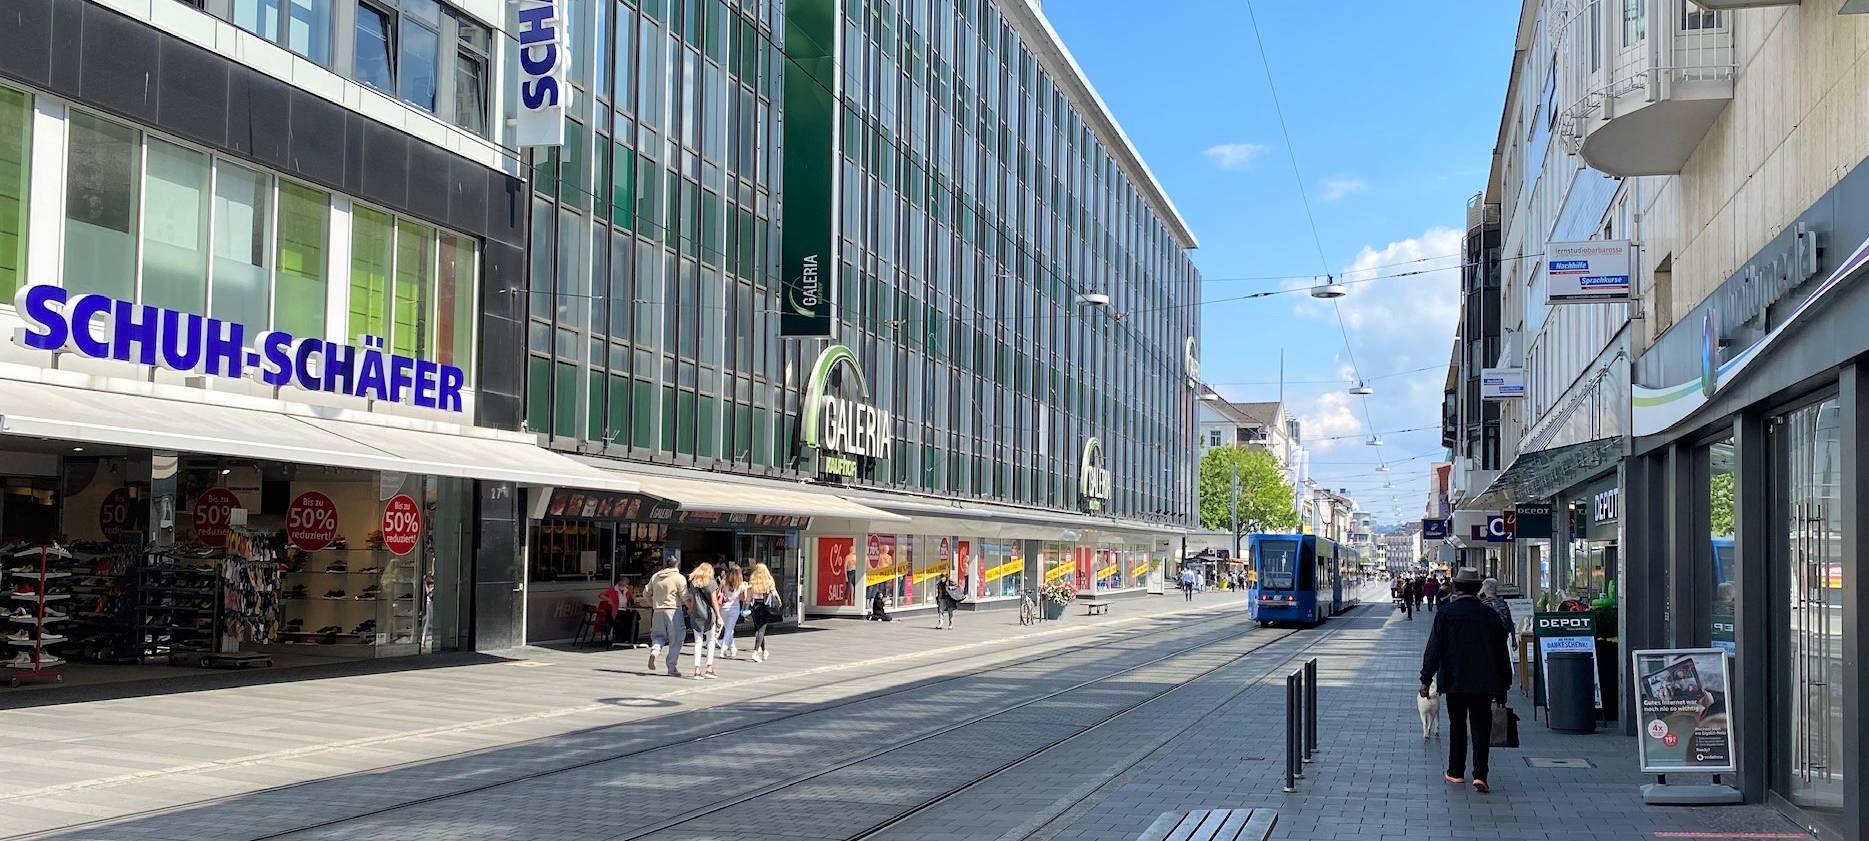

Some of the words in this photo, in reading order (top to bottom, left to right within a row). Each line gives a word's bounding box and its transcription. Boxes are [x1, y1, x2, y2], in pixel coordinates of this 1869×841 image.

[519, 0, 558, 109] SCH
[1555, 261, 1587, 269] Nachhilfe
[803, 254, 818, 306] GALERIA
[1581, 276, 1623, 286] Sprachkurse
[24, 284, 465, 412] SCHUH-SCHÄFER
[823, 395, 891, 459] GALERIA
[303, 498, 313, 506] Bis
[395, 501, 403, 509] Bis
[1594, 487, 1618, 521] DEPOT
[290, 508, 334, 530] 50%
[385, 511, 418, 532] 50%
[292, 530, 331, 541] reduziert!
[387, 534, 416, 544] reduziert!
[828, 584, 844, 601] SALE
[1540, 618, 1590, 627] DEPOT
